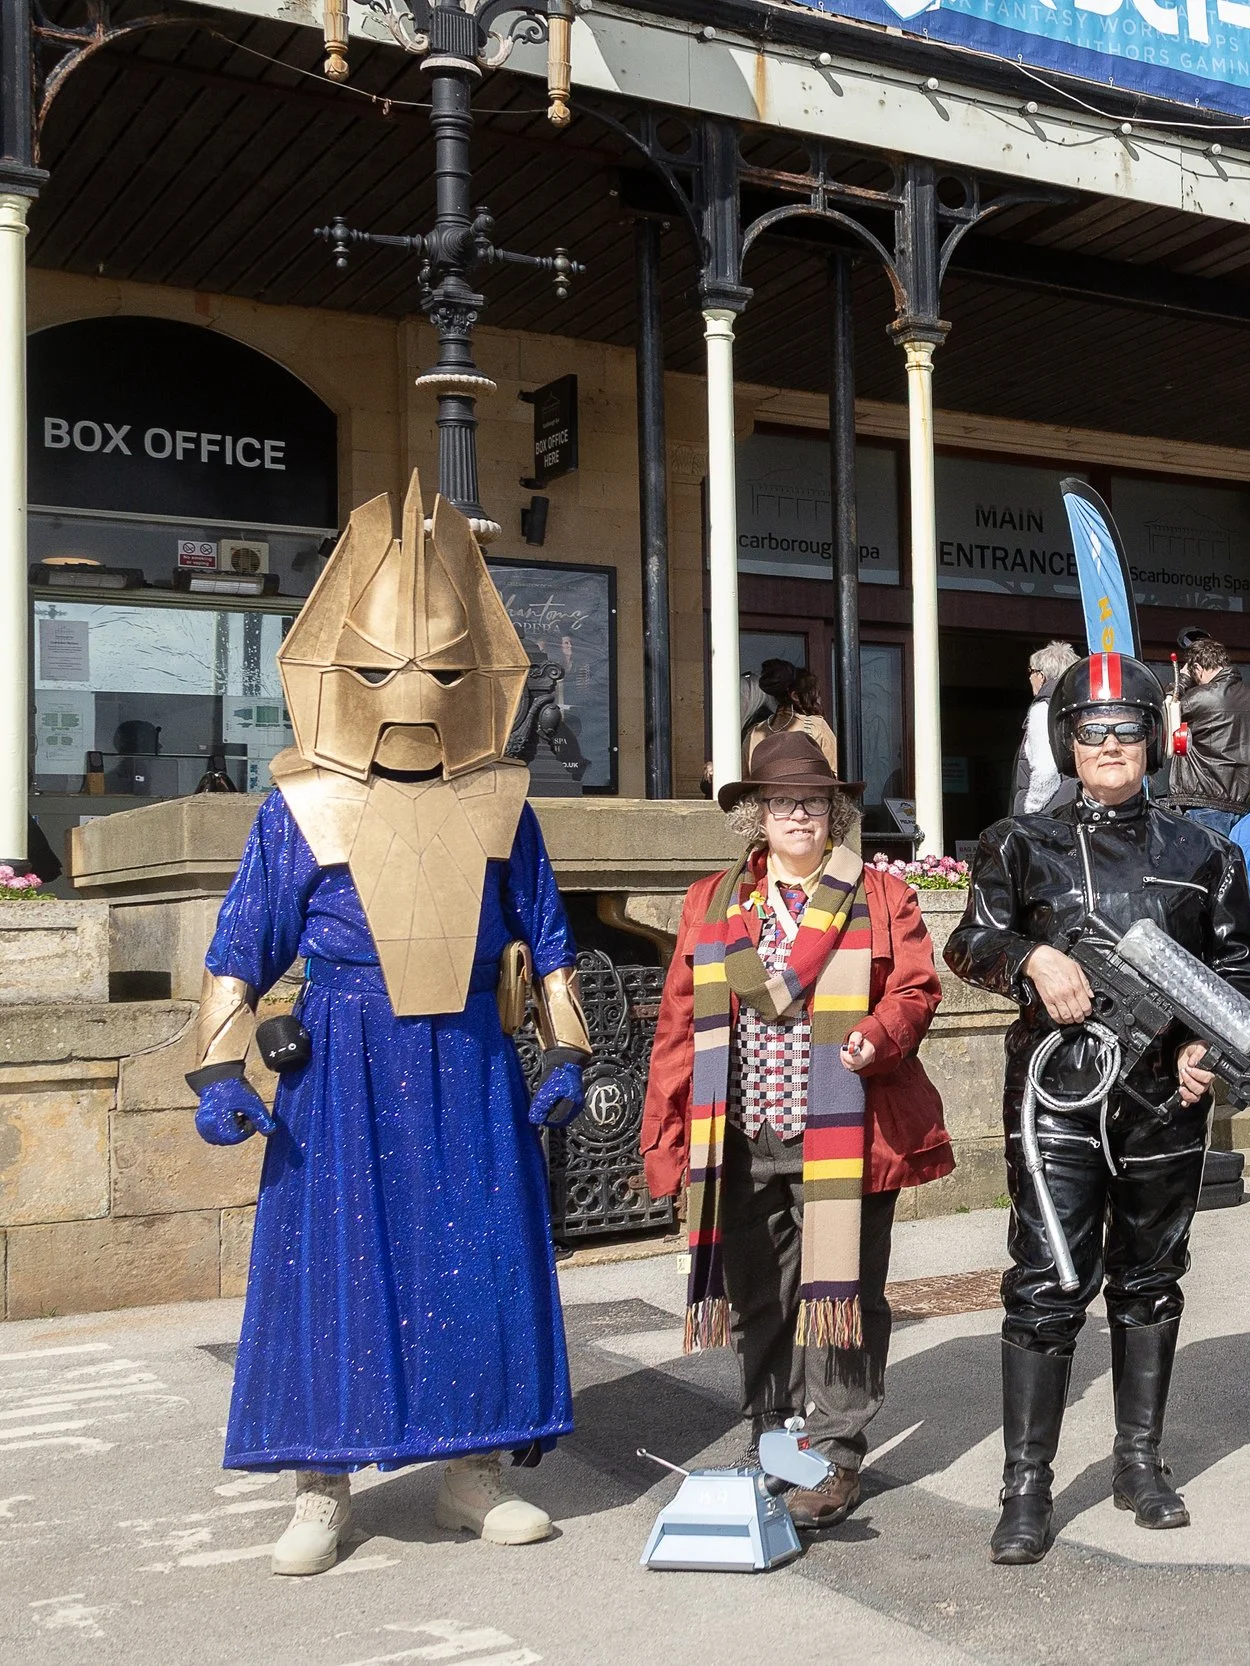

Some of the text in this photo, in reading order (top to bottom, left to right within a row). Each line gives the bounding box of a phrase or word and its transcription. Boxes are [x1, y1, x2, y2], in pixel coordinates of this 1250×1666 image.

[985, 0, 1088, 29] FANTASY
[44, 416, 286, 471] BOX OFFICE
[535, 429, 568, 455] BOX OFFICE
[543, 450, 560, 468] HERE
[975, 504, 1044, 533] MAIN
[738, 532, 880, 562] carboroug pa
[939, 541, 1078, 577] ENTRANCE
[1130, 566, 1250, 593] Scarborough Spa
